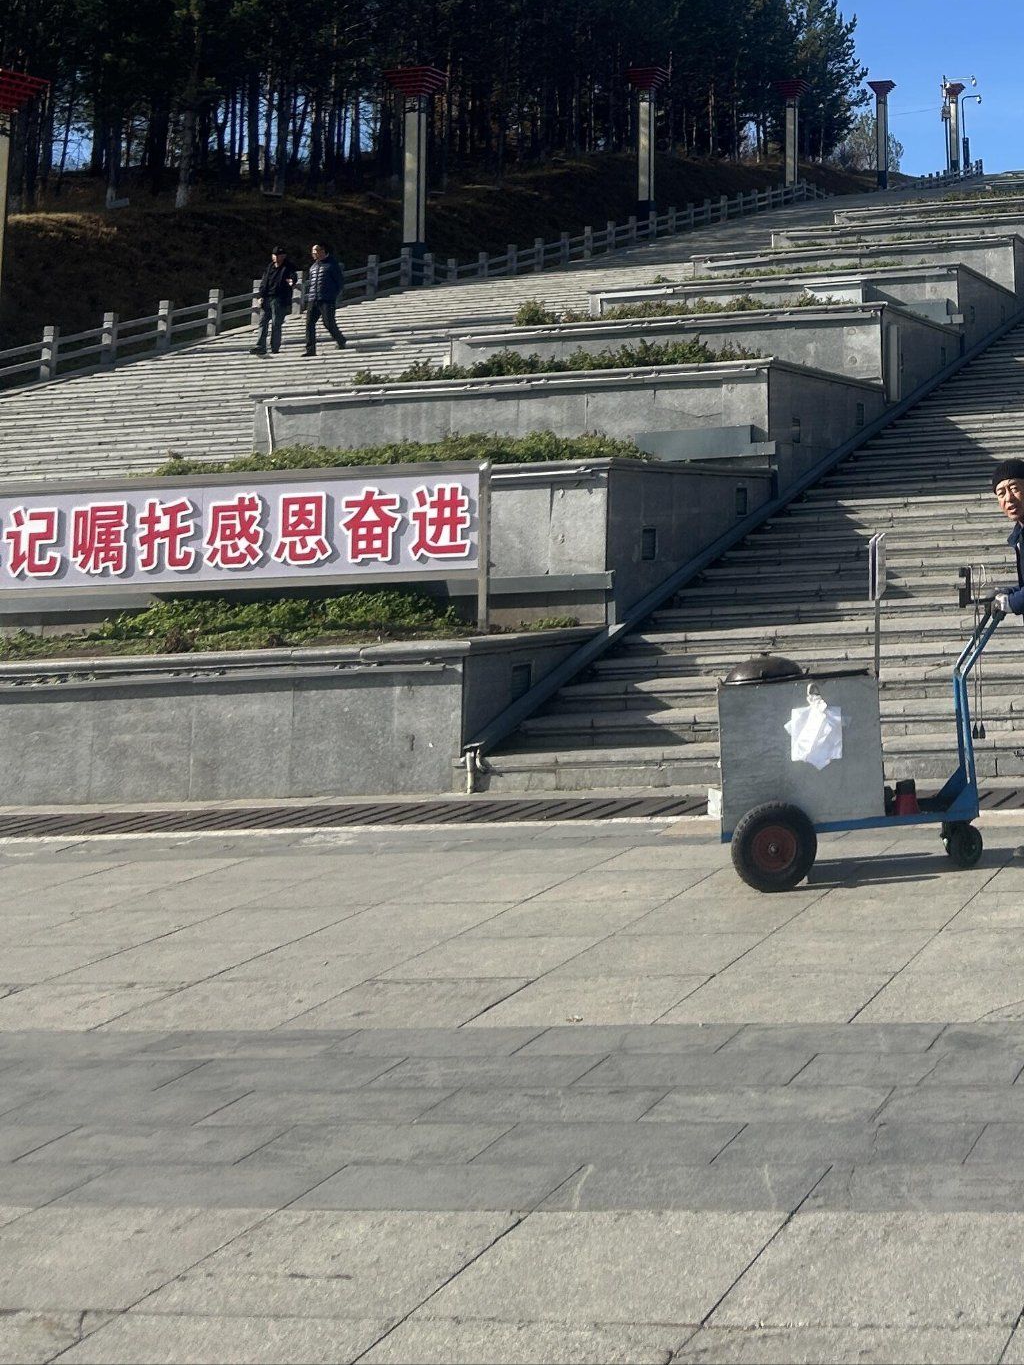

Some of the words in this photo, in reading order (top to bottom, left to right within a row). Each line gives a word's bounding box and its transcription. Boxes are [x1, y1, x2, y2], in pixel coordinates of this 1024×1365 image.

[4, 484, 470, 576] 记嘱托感恩奋进
